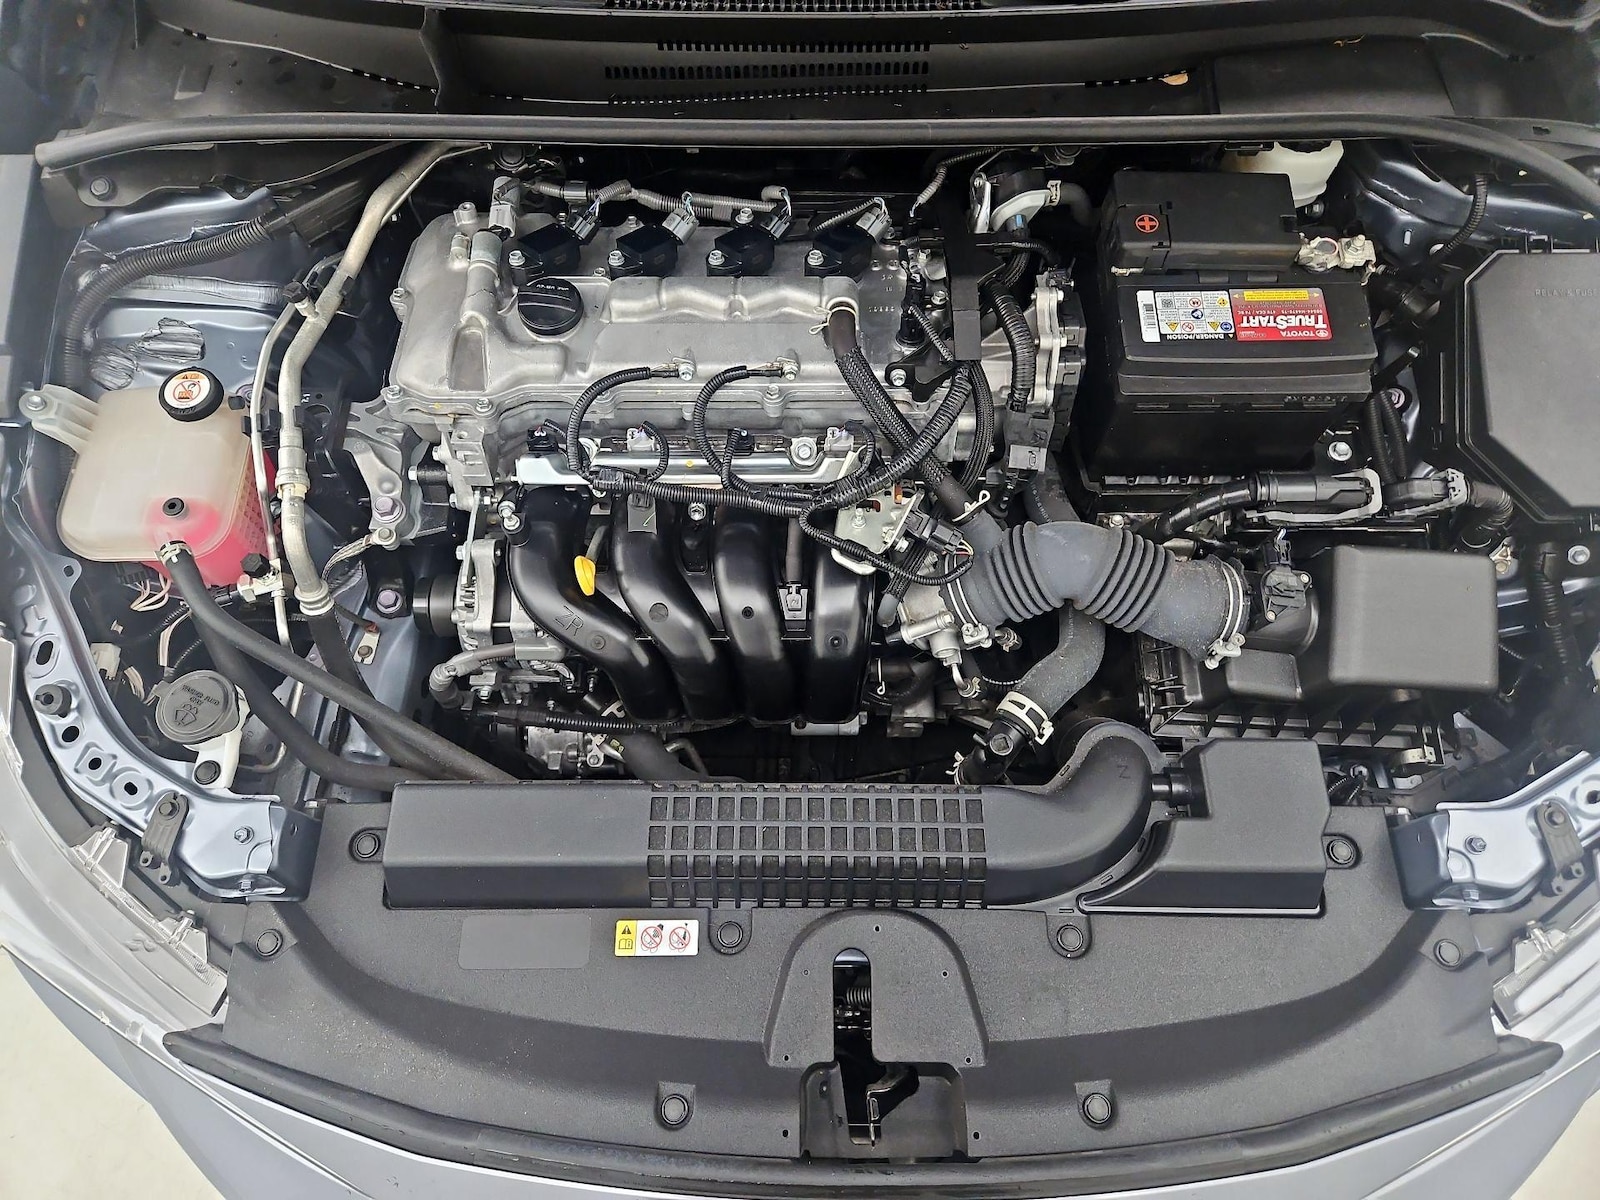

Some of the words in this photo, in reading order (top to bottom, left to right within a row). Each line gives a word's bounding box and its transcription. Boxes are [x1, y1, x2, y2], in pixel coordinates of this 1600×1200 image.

[1535, 288, 1564, 297] RELAY
[1167, 333, 1225, 341] DANGER/POISON
[554, 605, 584, 637] ZR
